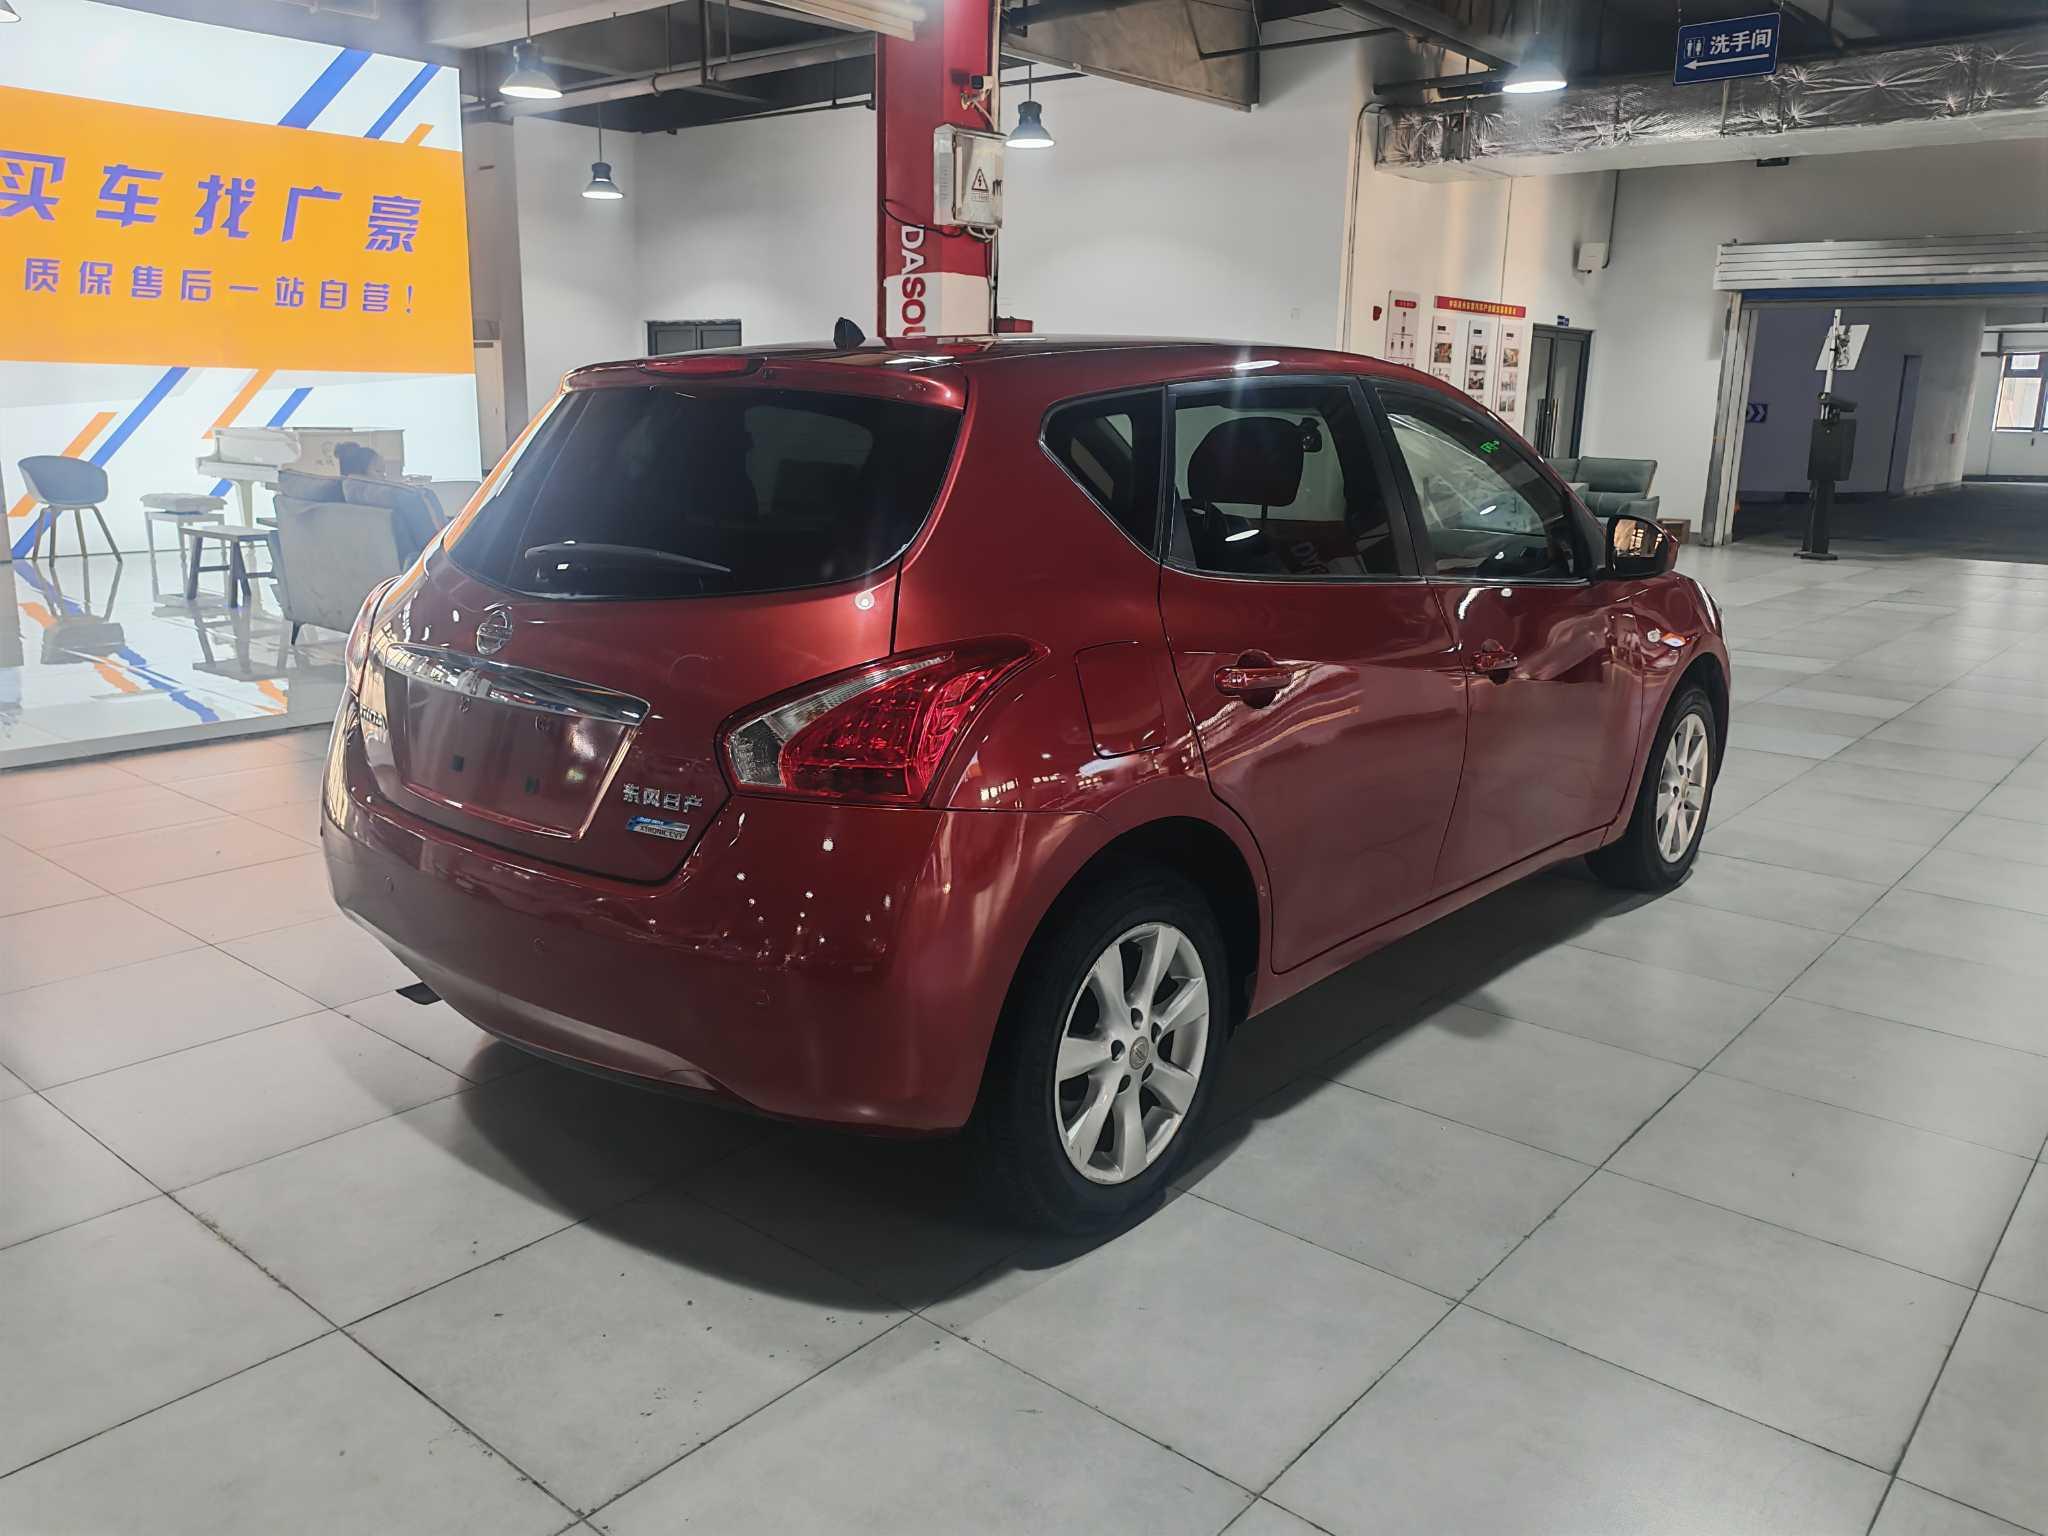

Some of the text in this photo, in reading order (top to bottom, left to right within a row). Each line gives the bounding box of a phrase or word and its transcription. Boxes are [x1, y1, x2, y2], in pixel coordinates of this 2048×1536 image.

[1709, 28, 1772, 55] 洗手间
[0, 149, 422, 253] 买车找广豪
[623, 783, 703, 813] 东风日产
